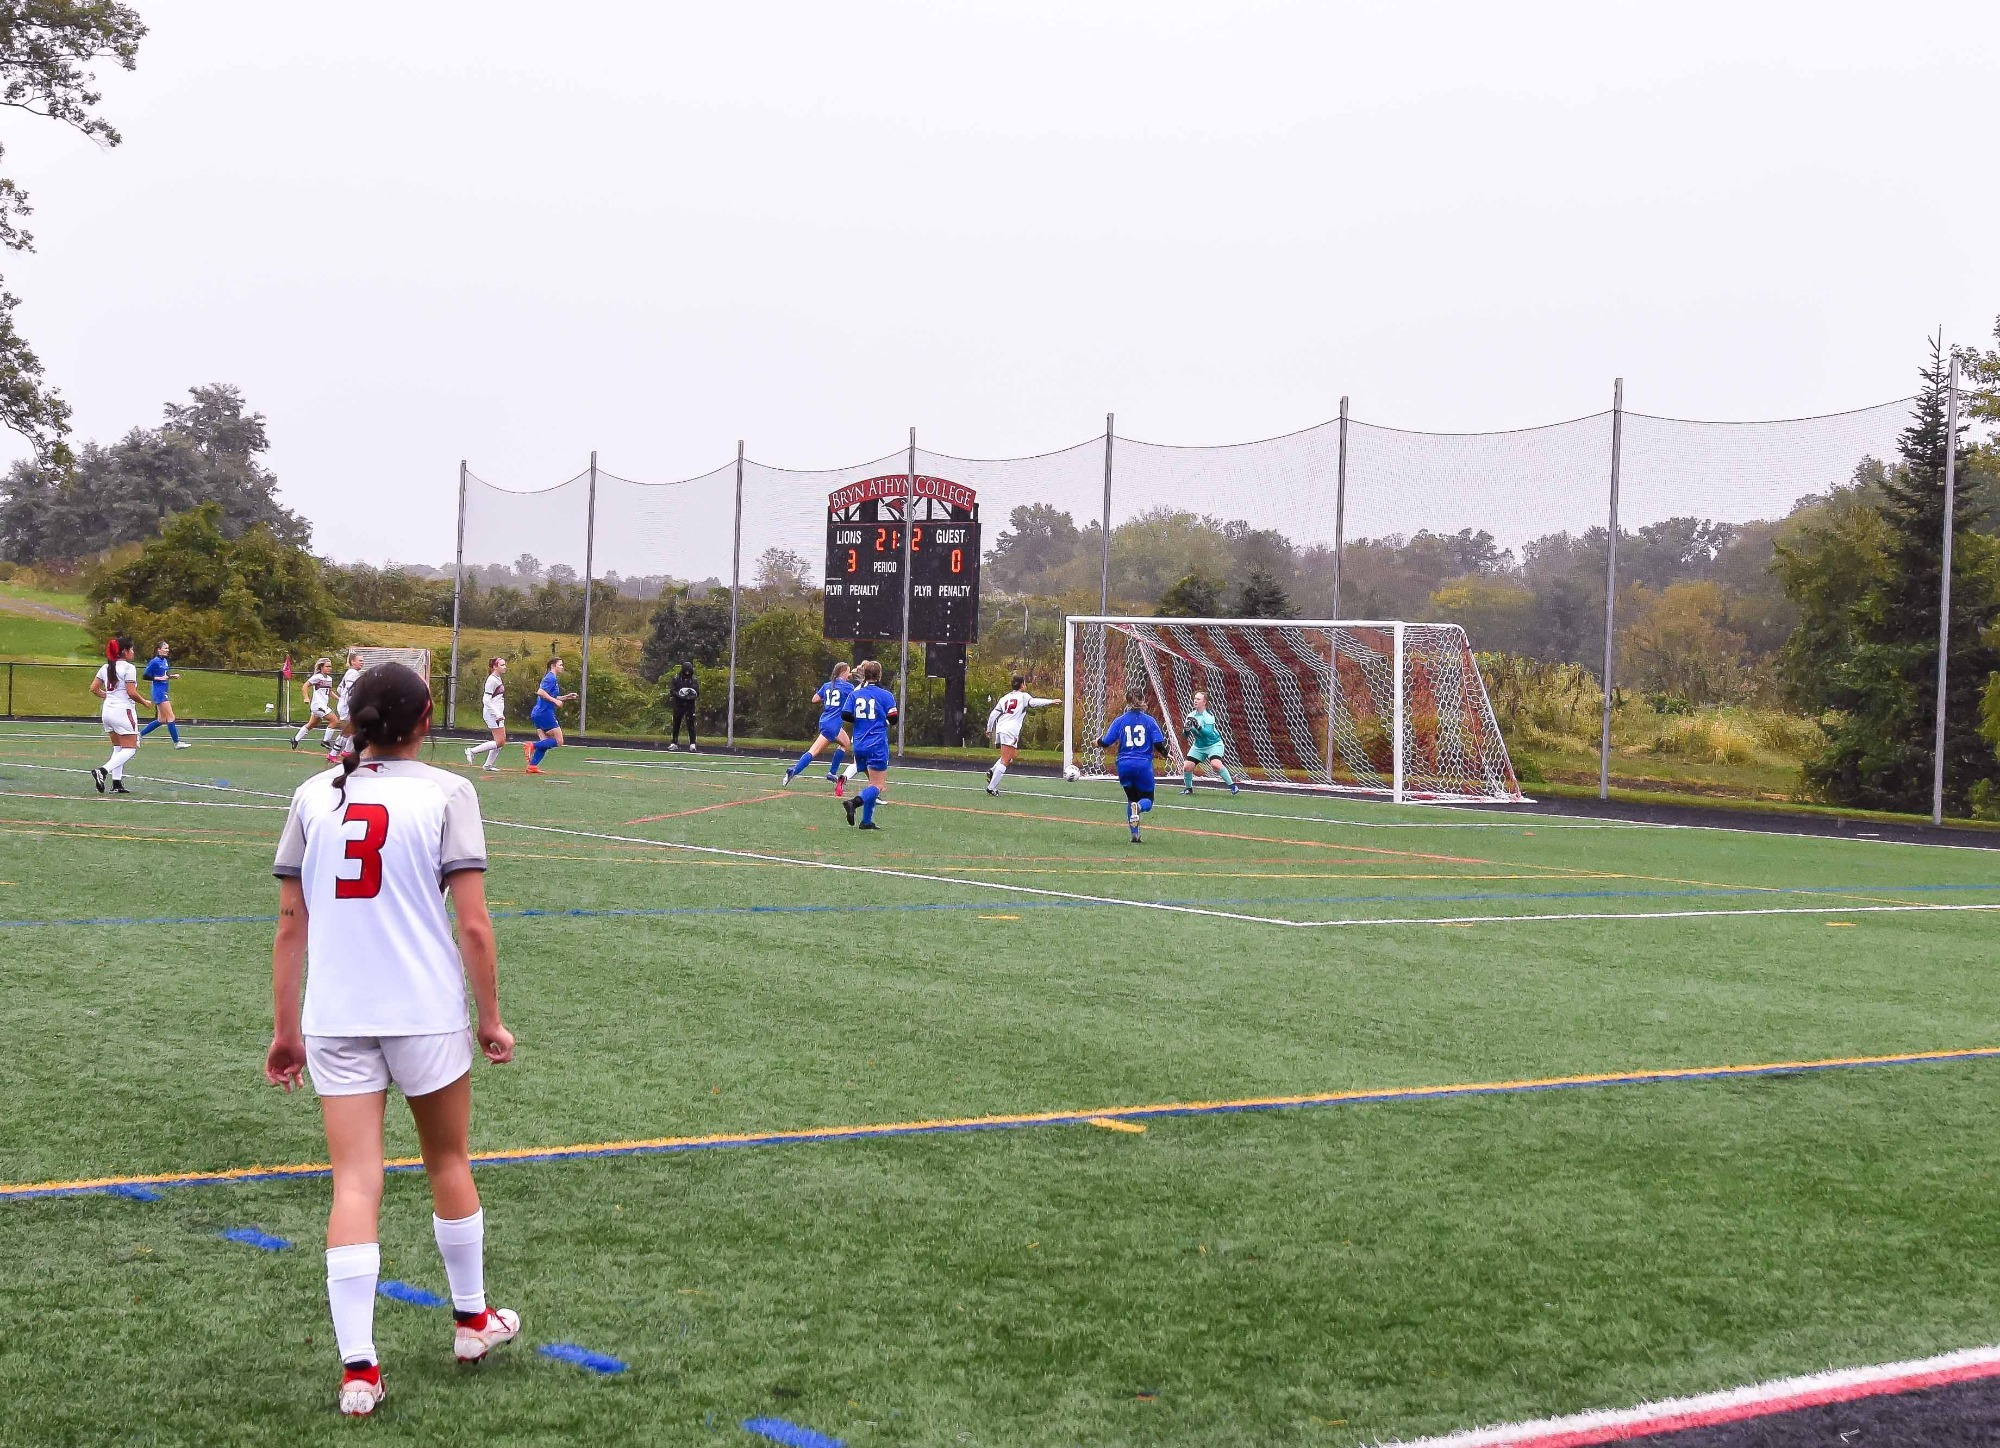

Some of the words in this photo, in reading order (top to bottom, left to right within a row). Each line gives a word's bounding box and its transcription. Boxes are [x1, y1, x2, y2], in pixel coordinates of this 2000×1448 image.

[832, 484, 864, 509] BRYN
[915, 476, 972, 507] COLLEGE
[836, 531, 862, 544] LIONS
[936, 529, 966, 544] GUEST
[847, 549, 857, 573] 3
[873, 561, 897, 573] PERIOD
[951, 549, 963, 573] 0
[825, 585, 842, 596] PLYR
[849, 585, 879, 596] PENALTY
[914, 585, 932, 597] PLYR
[938, 585, 971, 597] PENALTY
[825, 688, 841, 707] 12
[1003, 698, 1018, 714] 12
[855, 697, 876, 720] 21
[1124, 725, 1146, 747] 13
[335, 803, 389, 899] 3
